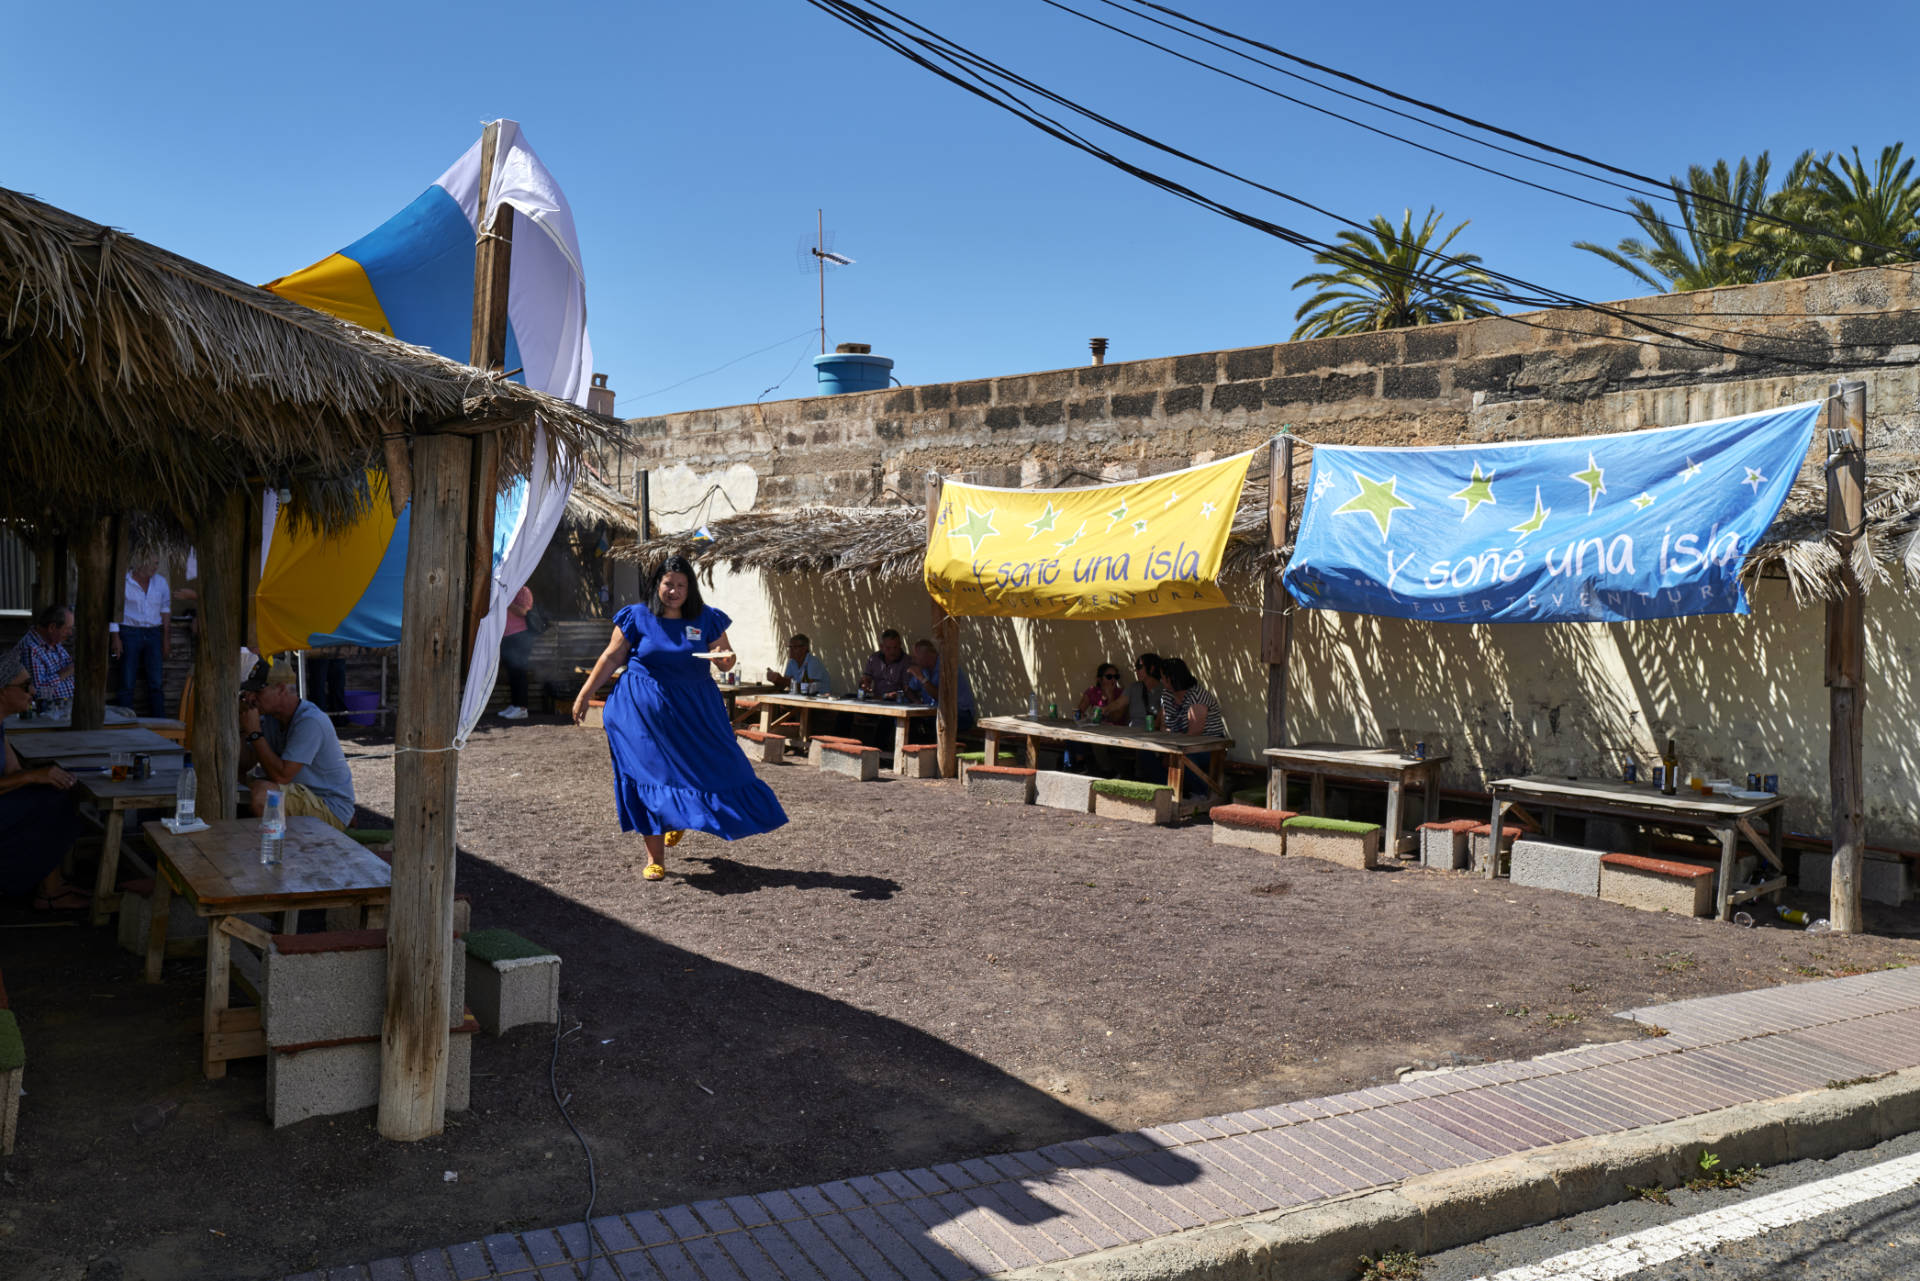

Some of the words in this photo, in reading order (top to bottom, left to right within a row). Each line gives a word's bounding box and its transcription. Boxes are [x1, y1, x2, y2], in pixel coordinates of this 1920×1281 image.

[1073, 552, 1131, 583] una
[1143, 540, 1201, 582] isla
[1423, 541, 1527, 590] soñé
[1545, 533, 1636, 578] una
[1659, 522, 1740, 576] isla
[1412, 583, 1737, 613] FUERTEVENTUR
